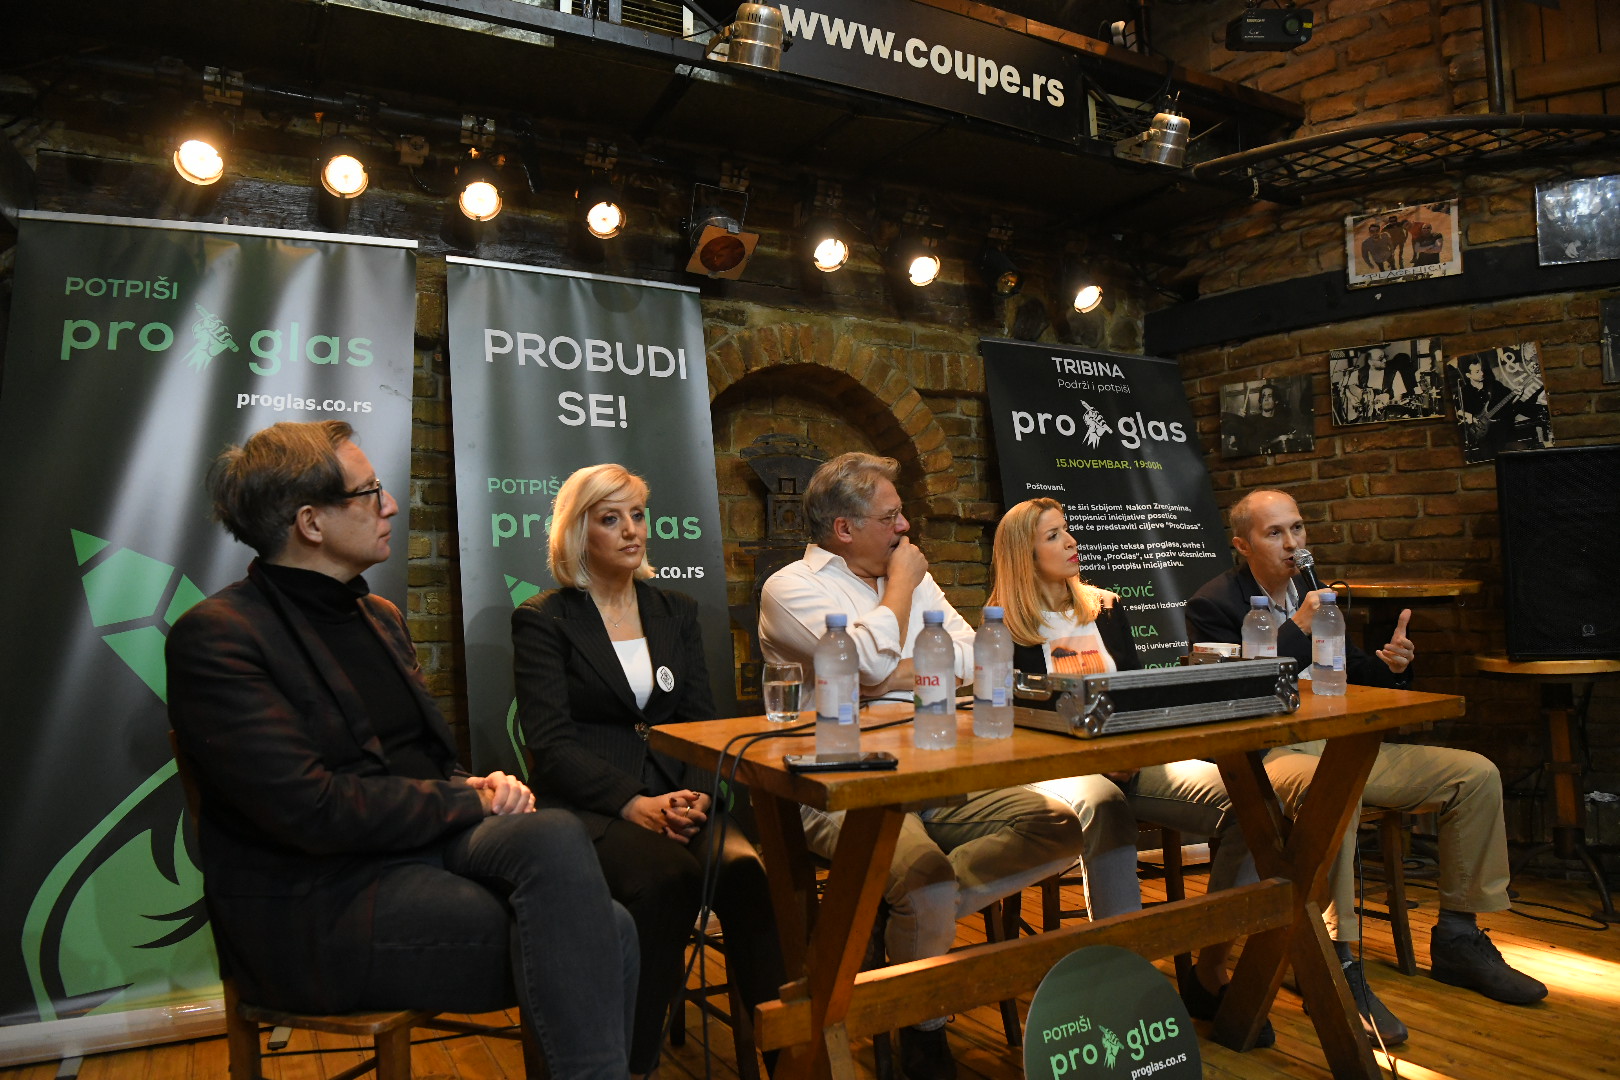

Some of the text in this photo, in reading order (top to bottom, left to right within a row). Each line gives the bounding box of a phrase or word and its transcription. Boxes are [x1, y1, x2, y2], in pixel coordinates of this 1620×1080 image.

[779, 4, 1065, 107] www.coupe.rs
[65, 276, 178, 300] POTPIŠI
[61, 319, 374, 377] pro glas
[484, 328, 688, 380] PROBUDI
[1051, 357, 1125, 379] TRIBINA
[1057, 378, 1131, 394] Podrži i potpiši
[237, 391, 373, 413] proglas.co.rs
[558, 391, 628, 429] SE!
[1011, 409, 1187, 450] pro glas
[1055, 458, 1163, 470] 15.NOVEMBAR, 19:00h
[487, 475, 564, 495] POTPIŠ
[1026, 482, 1066, 492] Poštovani,
[1069, 513, 1107, 522] potpisnici
[1108, 513, 1146, 522] inicijative
[1077, 503, 1090, 511] širi
[1090, 503, 1123, 513] Srbijom!
[1125, 503, 1152, 511] Nakon
[645, 507, 702, 540] las
[1069, 523, 1084, 532] gde
[1096, 522, 1137, 531] predstaviti
[1138, 521, 1165, 531] ciljeve
[1077, 542, 1119, 552] dstavljanje
[1120, 542, 1145, 550] teksta
[1155, 550, 1177, 560] poziv
[1177, 550, 1217, 558] učesnicima
[1080, 562, 1106, 571] podrže
[1111, 562, 1141, 572] potpišu
[1142, 560, 1185, 570] inicijativu.
[1042, 1015, 1092, 1043] POTPIŠI
[1049, 1017, 1180, 1080] pro glas
[1131, 1052, 1187, 1080] proglas.co.rs
